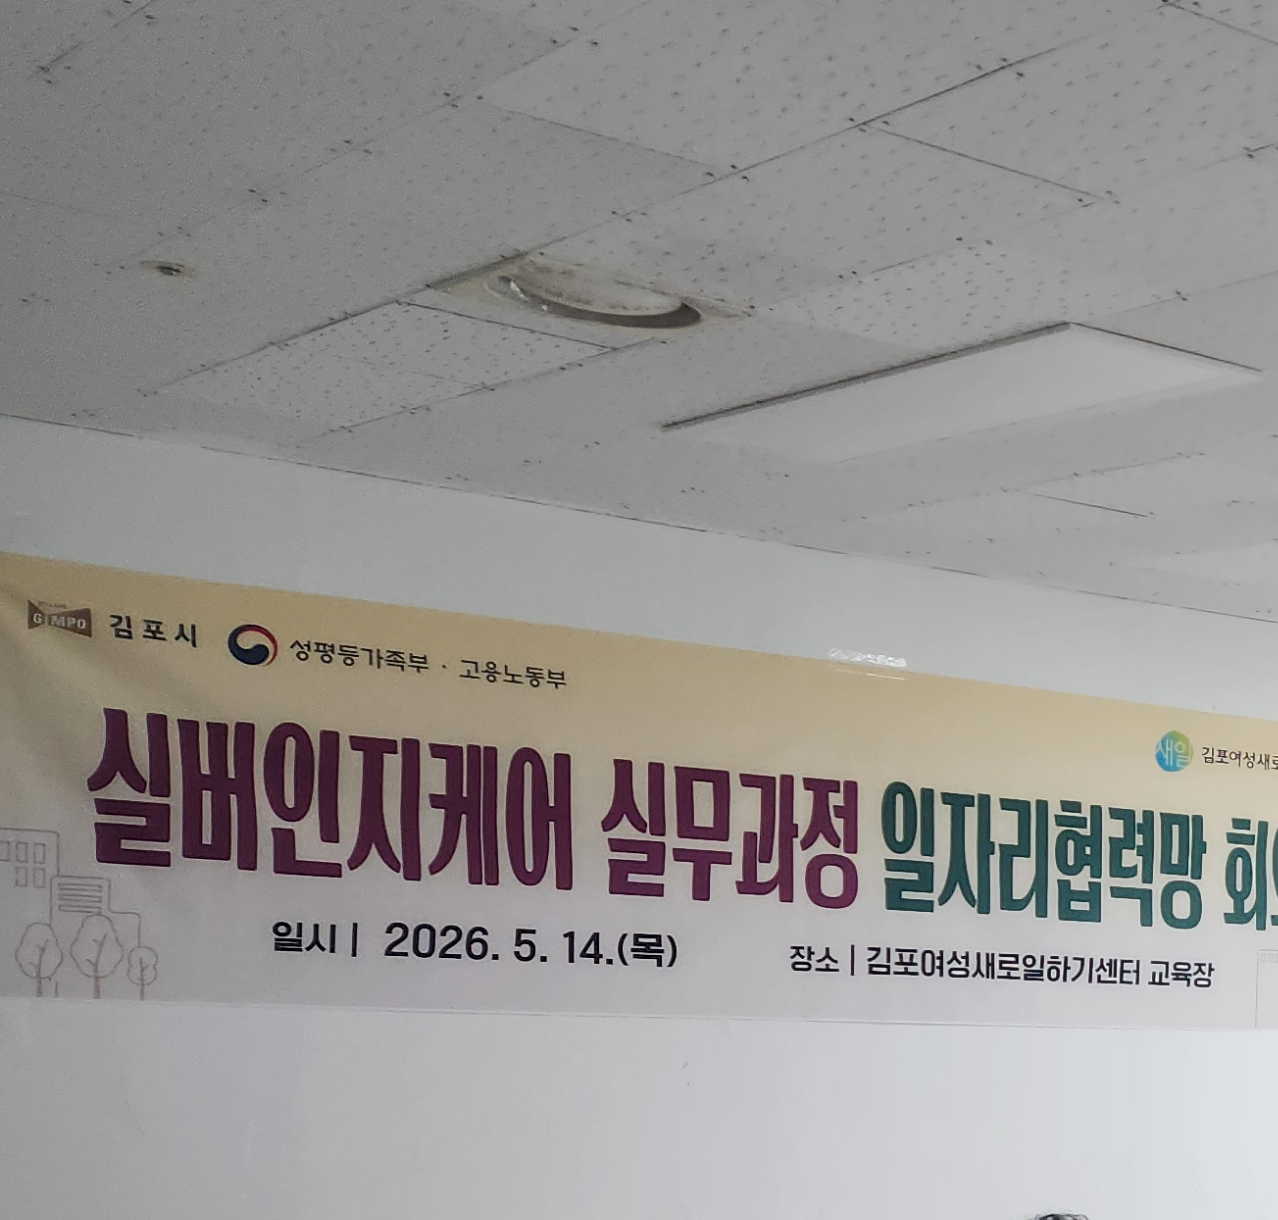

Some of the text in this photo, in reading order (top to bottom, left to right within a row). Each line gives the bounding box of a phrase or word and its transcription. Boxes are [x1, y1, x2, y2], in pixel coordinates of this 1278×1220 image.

[109, 614, 198, 648] 김포시
[290, 639, 567, 690] 성평등가족부 고용노동부
[87, 707, 574, 891] 실버인지케어
[601, 758, 859, 910] 실무과정
[880, 781, 1207, 930] 일자리협력망
[271, 921, 679, 969] 일시 2026. 5. 14.(목)
[788, 944, 1215, 989] 장소 김포여성새로일하기센터 교육장
